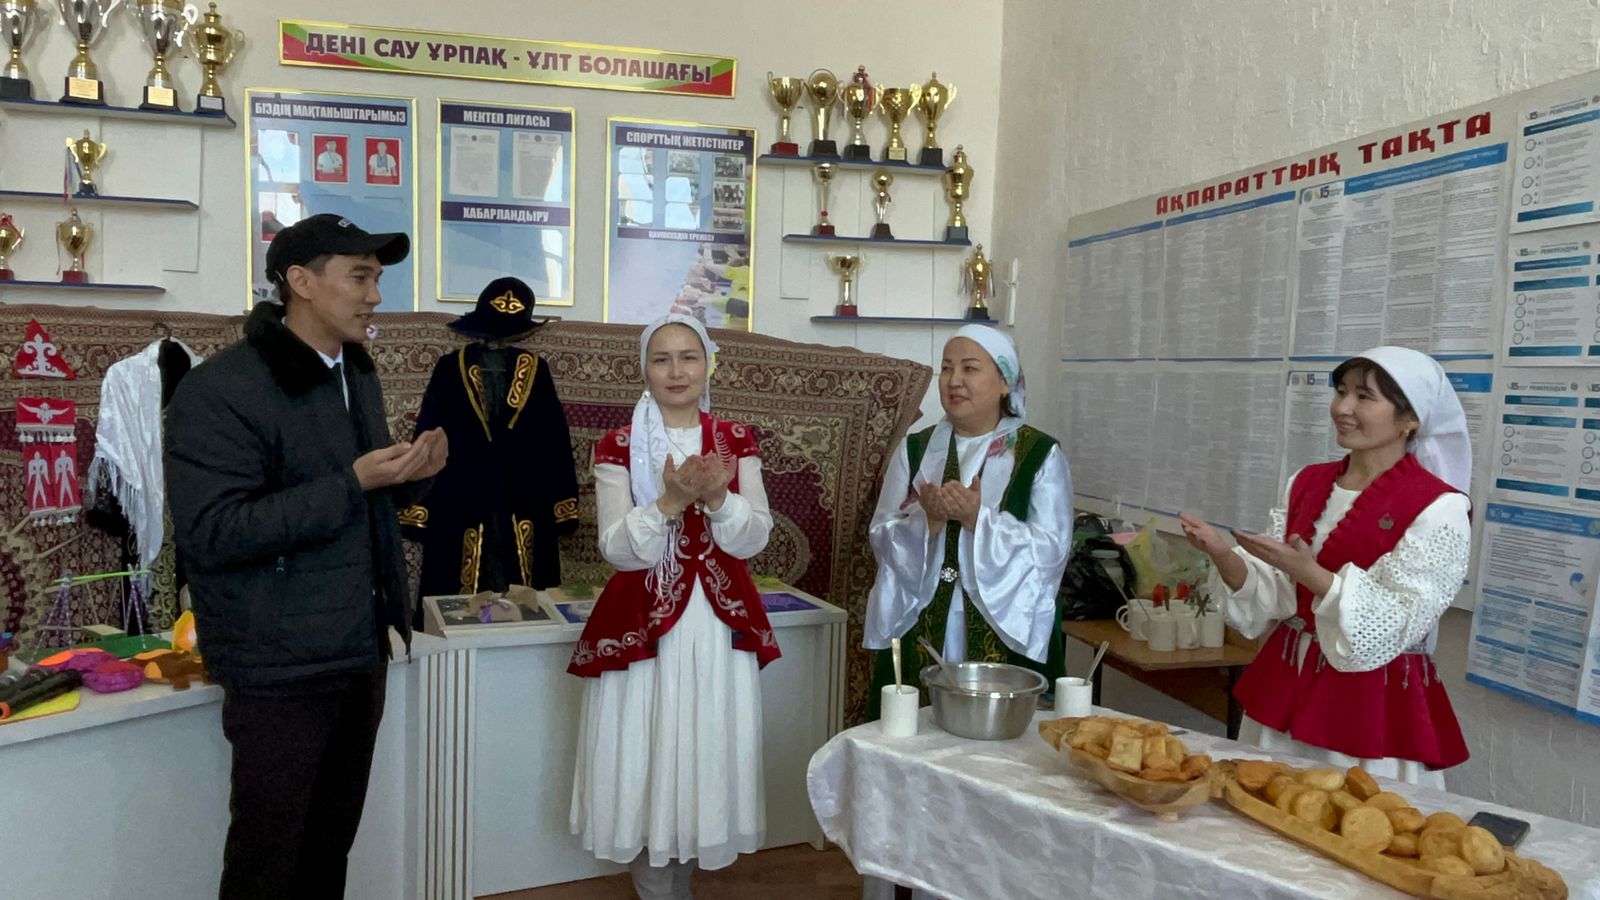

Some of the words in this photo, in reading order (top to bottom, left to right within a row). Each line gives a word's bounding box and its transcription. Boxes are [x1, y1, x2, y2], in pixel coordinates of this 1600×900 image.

[305, 32, 366, 55] ДЕНІ
[373, 38, 420, 59] САУ
[426, 42, 507, 69] ҰРПАҚ
[527, 50, 572, 72] ҰЛТ
[578, 55, 711, 83] БОЛАШАҒЫ
[255, 102, 292, 118] БІЗДІҢ
[293, 104, 406, 123] МАҚТАНЫШТАРЫМЫЗ
[463, 110, 504, 125] МЕКТЕП
[505, 113, 550, 128] ЛИГАСЫ
[626, 131, 682, 148] СПОРТТЫҚ
[682, 135, 744, 151] ЖЕТІСТІКТЕР
[1156, 152, 1340, 215] АҚПАРАТТЫҚ
[1358, 111, 1491, 164] ТАҚТА
[1320, 185, 1330, 199] 15
[463, 206, 549, 222] ХАБАРЛАНДЫРУ
[1307, 372, 1315, 385] 15
